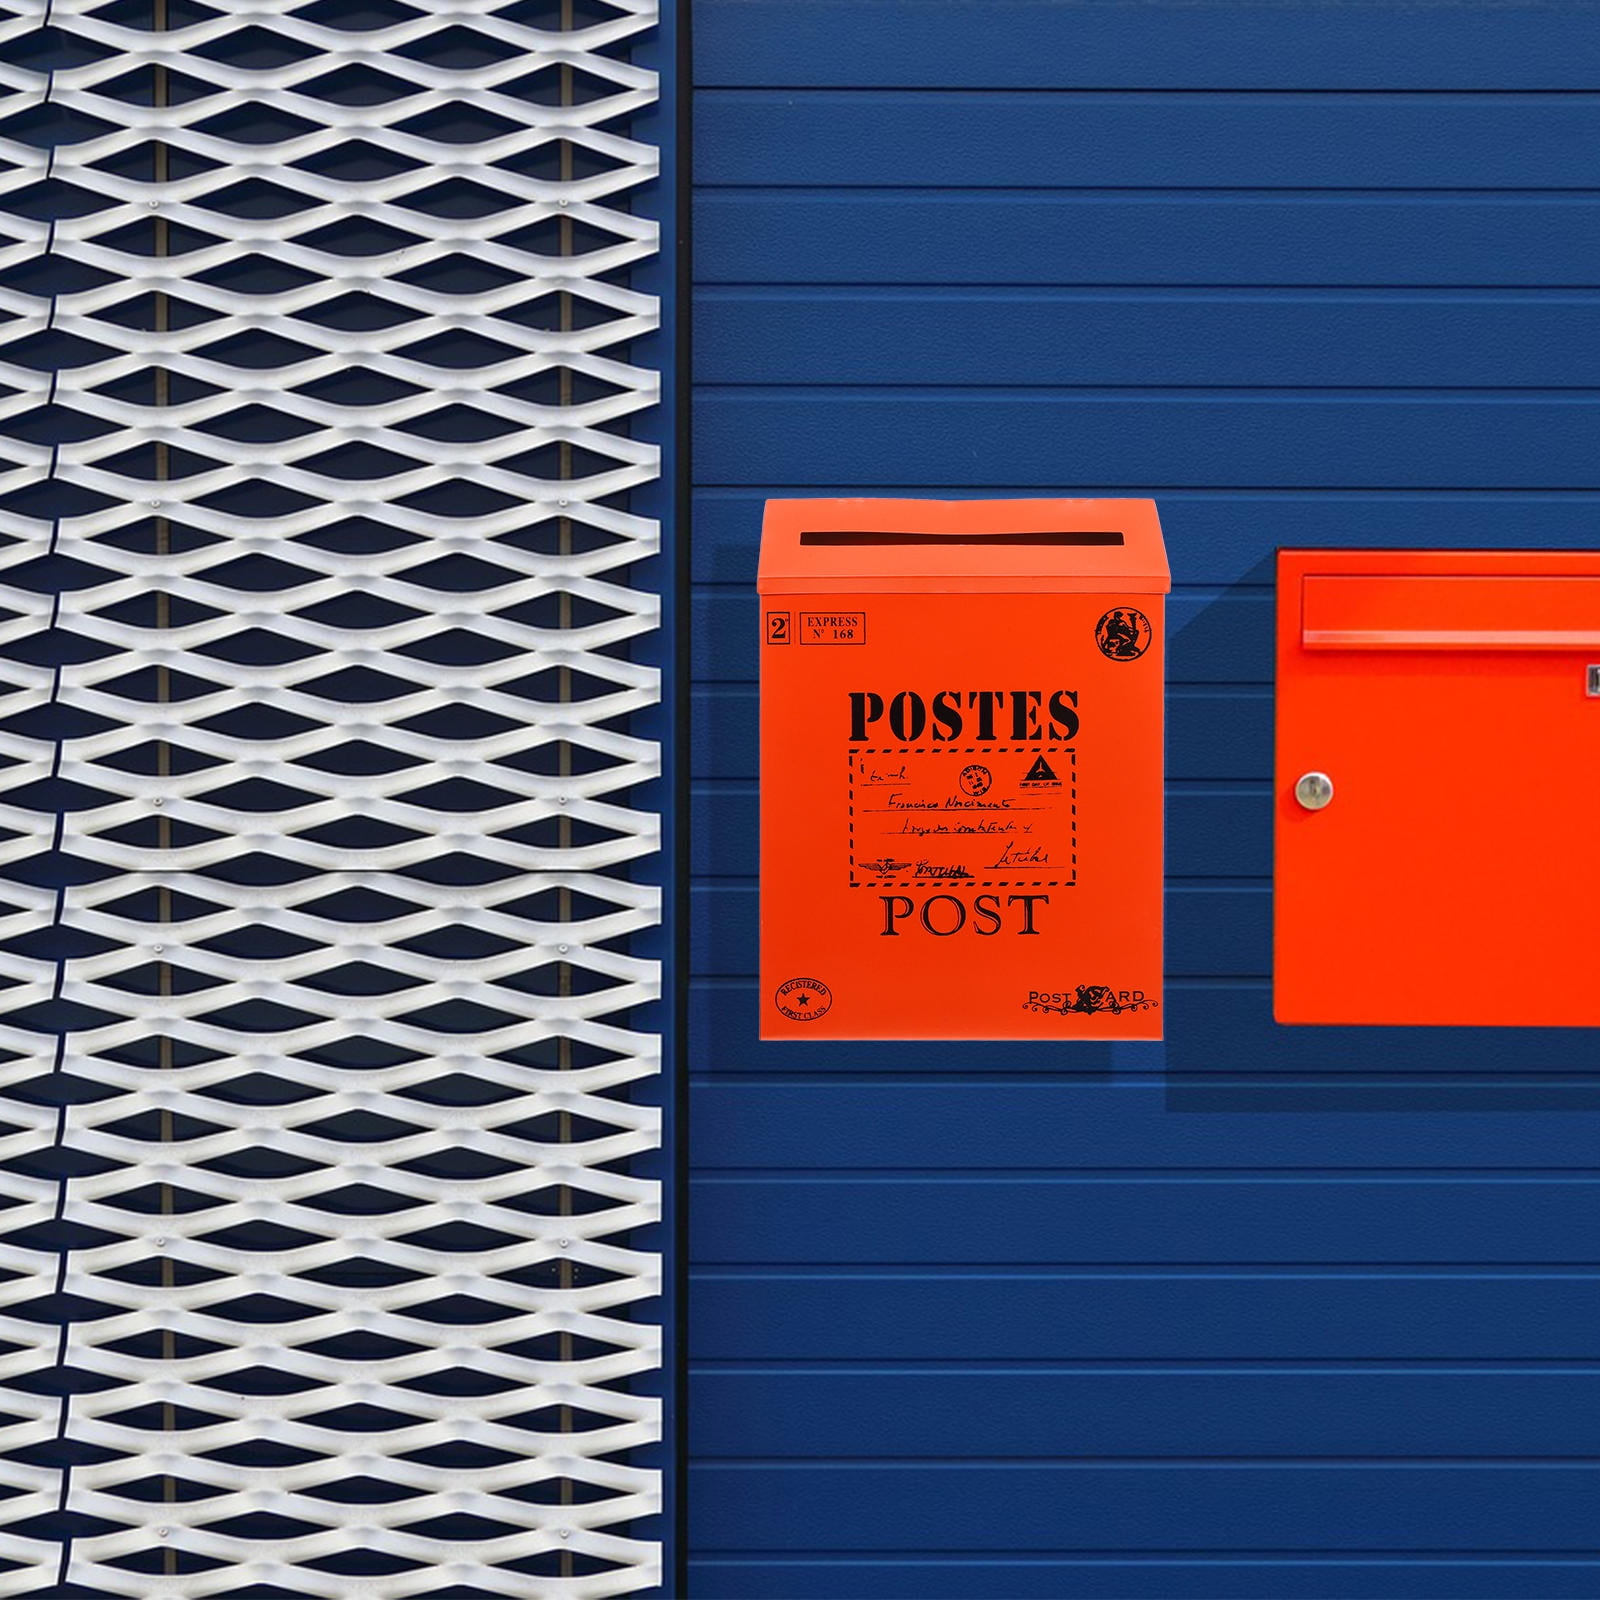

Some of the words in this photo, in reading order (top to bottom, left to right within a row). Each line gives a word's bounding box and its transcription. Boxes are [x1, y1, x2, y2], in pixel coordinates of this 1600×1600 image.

[807, 616, 858, 628] EXPRESS
[833, 628, 854, 640] 168
[848, 690, 1080, 742] POSTES
[879, 894, 1050, 936] POST
[780, 980, 827, 996] REGISTERED
[780, 1005, 802, 1019] FIRST
